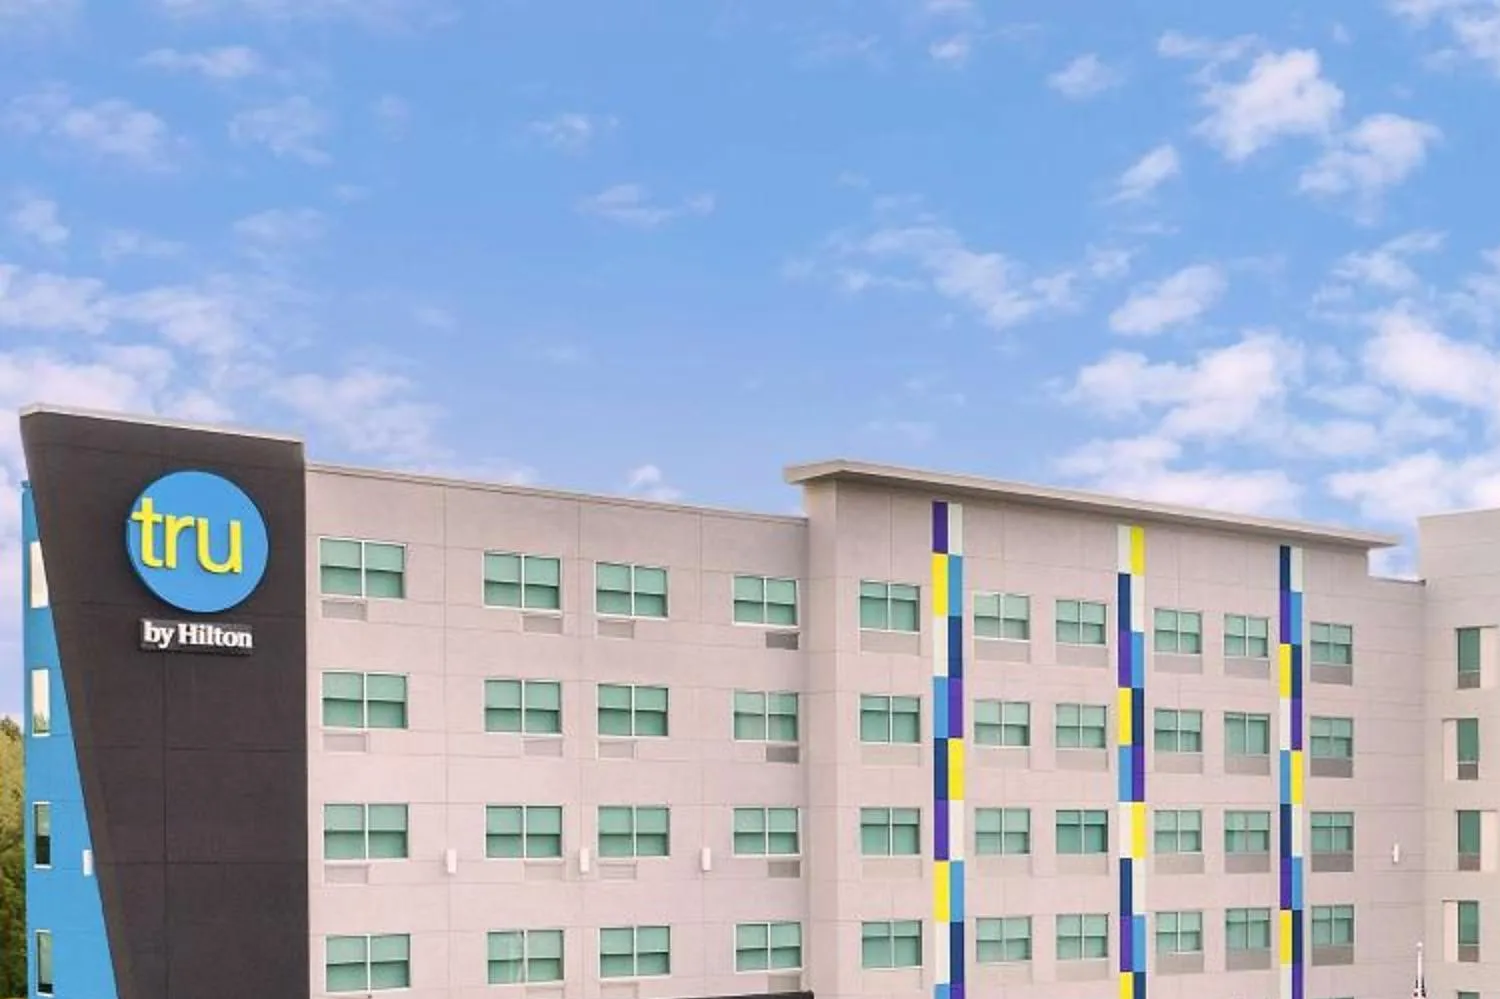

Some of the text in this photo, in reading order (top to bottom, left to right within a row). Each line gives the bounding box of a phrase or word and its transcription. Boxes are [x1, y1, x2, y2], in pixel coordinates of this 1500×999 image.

[131, 496, 244, 574] tru
[143, 619, 254, 649] by Hilton
